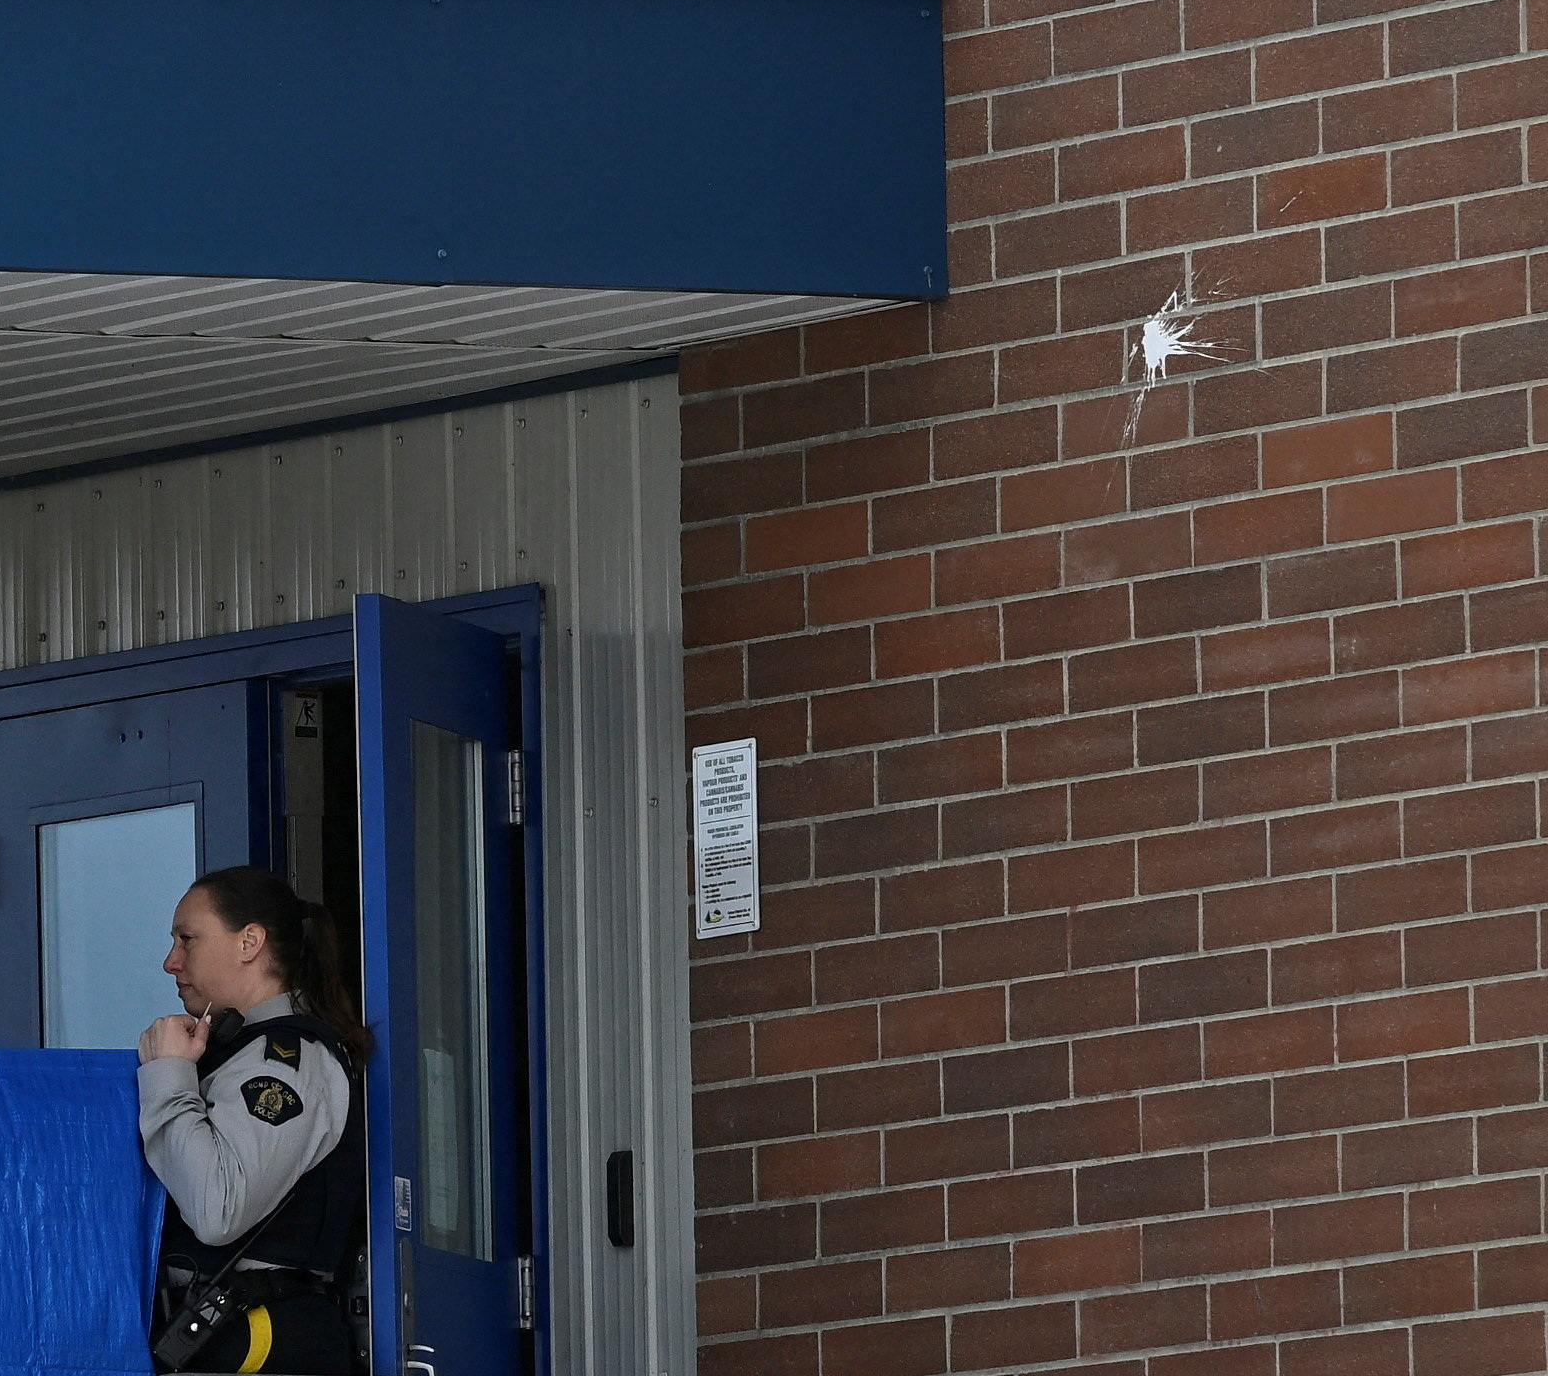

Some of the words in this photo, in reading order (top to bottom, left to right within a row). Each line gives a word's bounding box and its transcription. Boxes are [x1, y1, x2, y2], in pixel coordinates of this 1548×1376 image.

[248, 1081, 268, 1089] RCMP
[282, 1090, 295, 1105] GRC
[254, 1105, 277, 1121] POLICE
